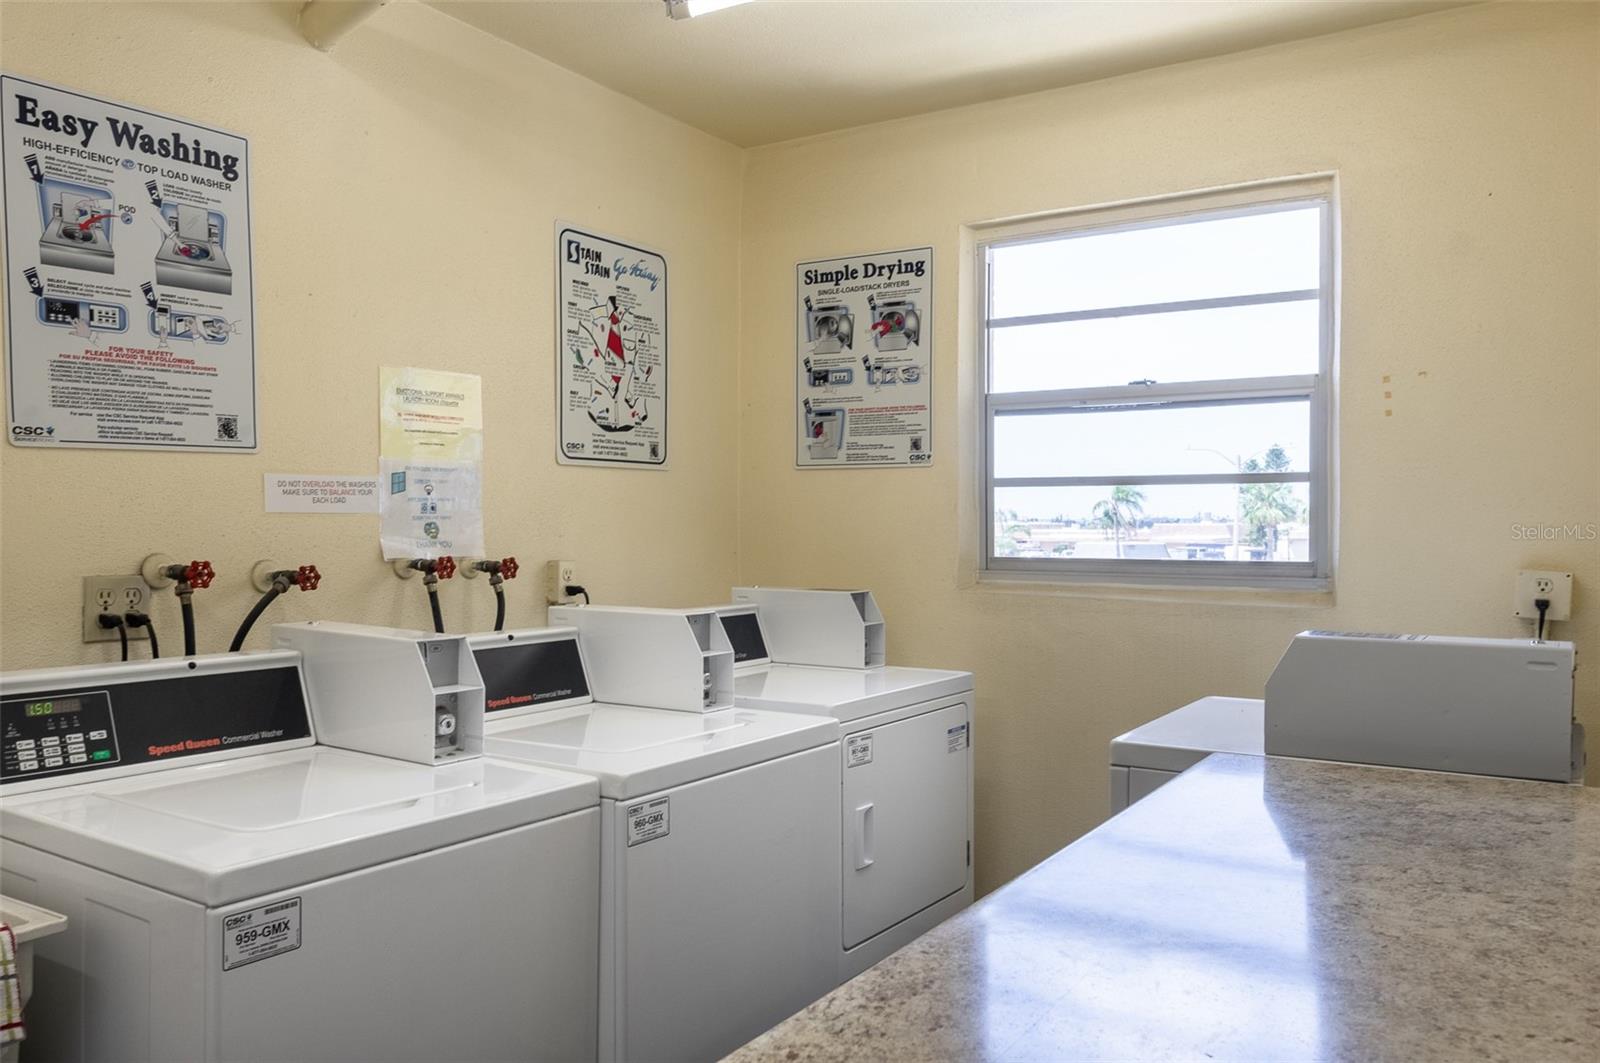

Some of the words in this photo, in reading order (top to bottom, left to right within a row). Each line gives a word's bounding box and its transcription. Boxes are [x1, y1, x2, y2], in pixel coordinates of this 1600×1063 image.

[15, 94, 98, 148] Easy
[106, 117, 239, 181] Washing
[23, 137, 120, 167] HIGH-EFFICIENCY
[138, 163, 158, 174] TOP
[161, 168, 188, 182] LOAD
[191, 174, 232, 192] WASHER
[118, 204, 136, 214] POD
[567, 239, 602, 264] STAIN
[584, 262, 610, 279] STAIN
[804, 264, 858, 286] Simple
[863, 258, 925, 280] Drying
[883, 280, 910, 289] DRYERS
[84, 349, 112, 358] PLEASE
[115, 352, 138, 360] AVOID
[154, 355, 195, 365] FOLLOWING
[146, 349, 173, 357] SAFETY
[12, 425, 44, 436] CSC
[566, 442, 580, 450] CSC
[487, 697, 510, 708] Speed
[510, 695, 533, 703] Queen
[533, 691, 557, 700] Commercial
[148, 742, 185, 756] Speed
[185, 737, 221, 750] Queen
[222, 733, 260, 744] Commercial
[261, 729, 284, 738] Washer
[235, 919, 290, 946] 959-GMX
